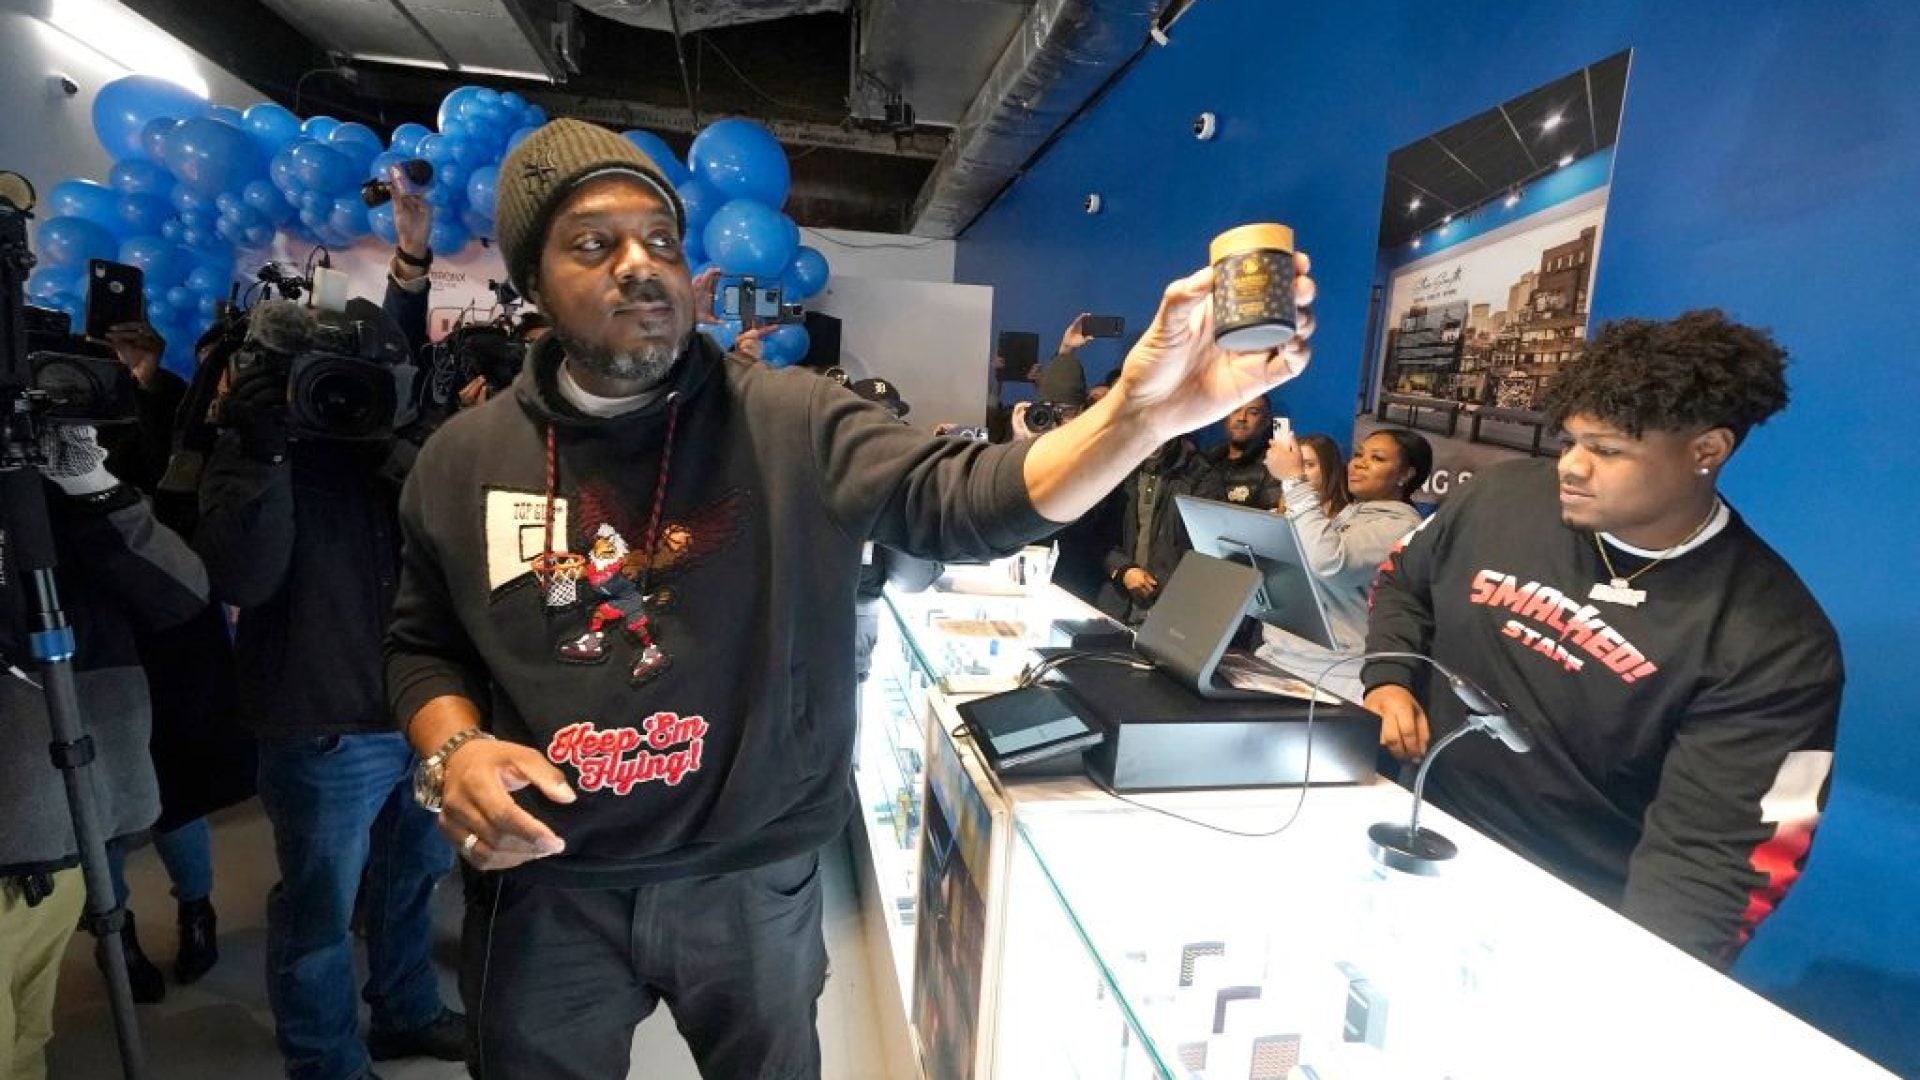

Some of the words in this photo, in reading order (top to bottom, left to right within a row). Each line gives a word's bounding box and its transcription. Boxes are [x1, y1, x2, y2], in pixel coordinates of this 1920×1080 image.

[1470, 569, 1659, 684] SMACKED!
[548, 721, 642, 768] Keep
[578, 738, 703, 795] Flying!
